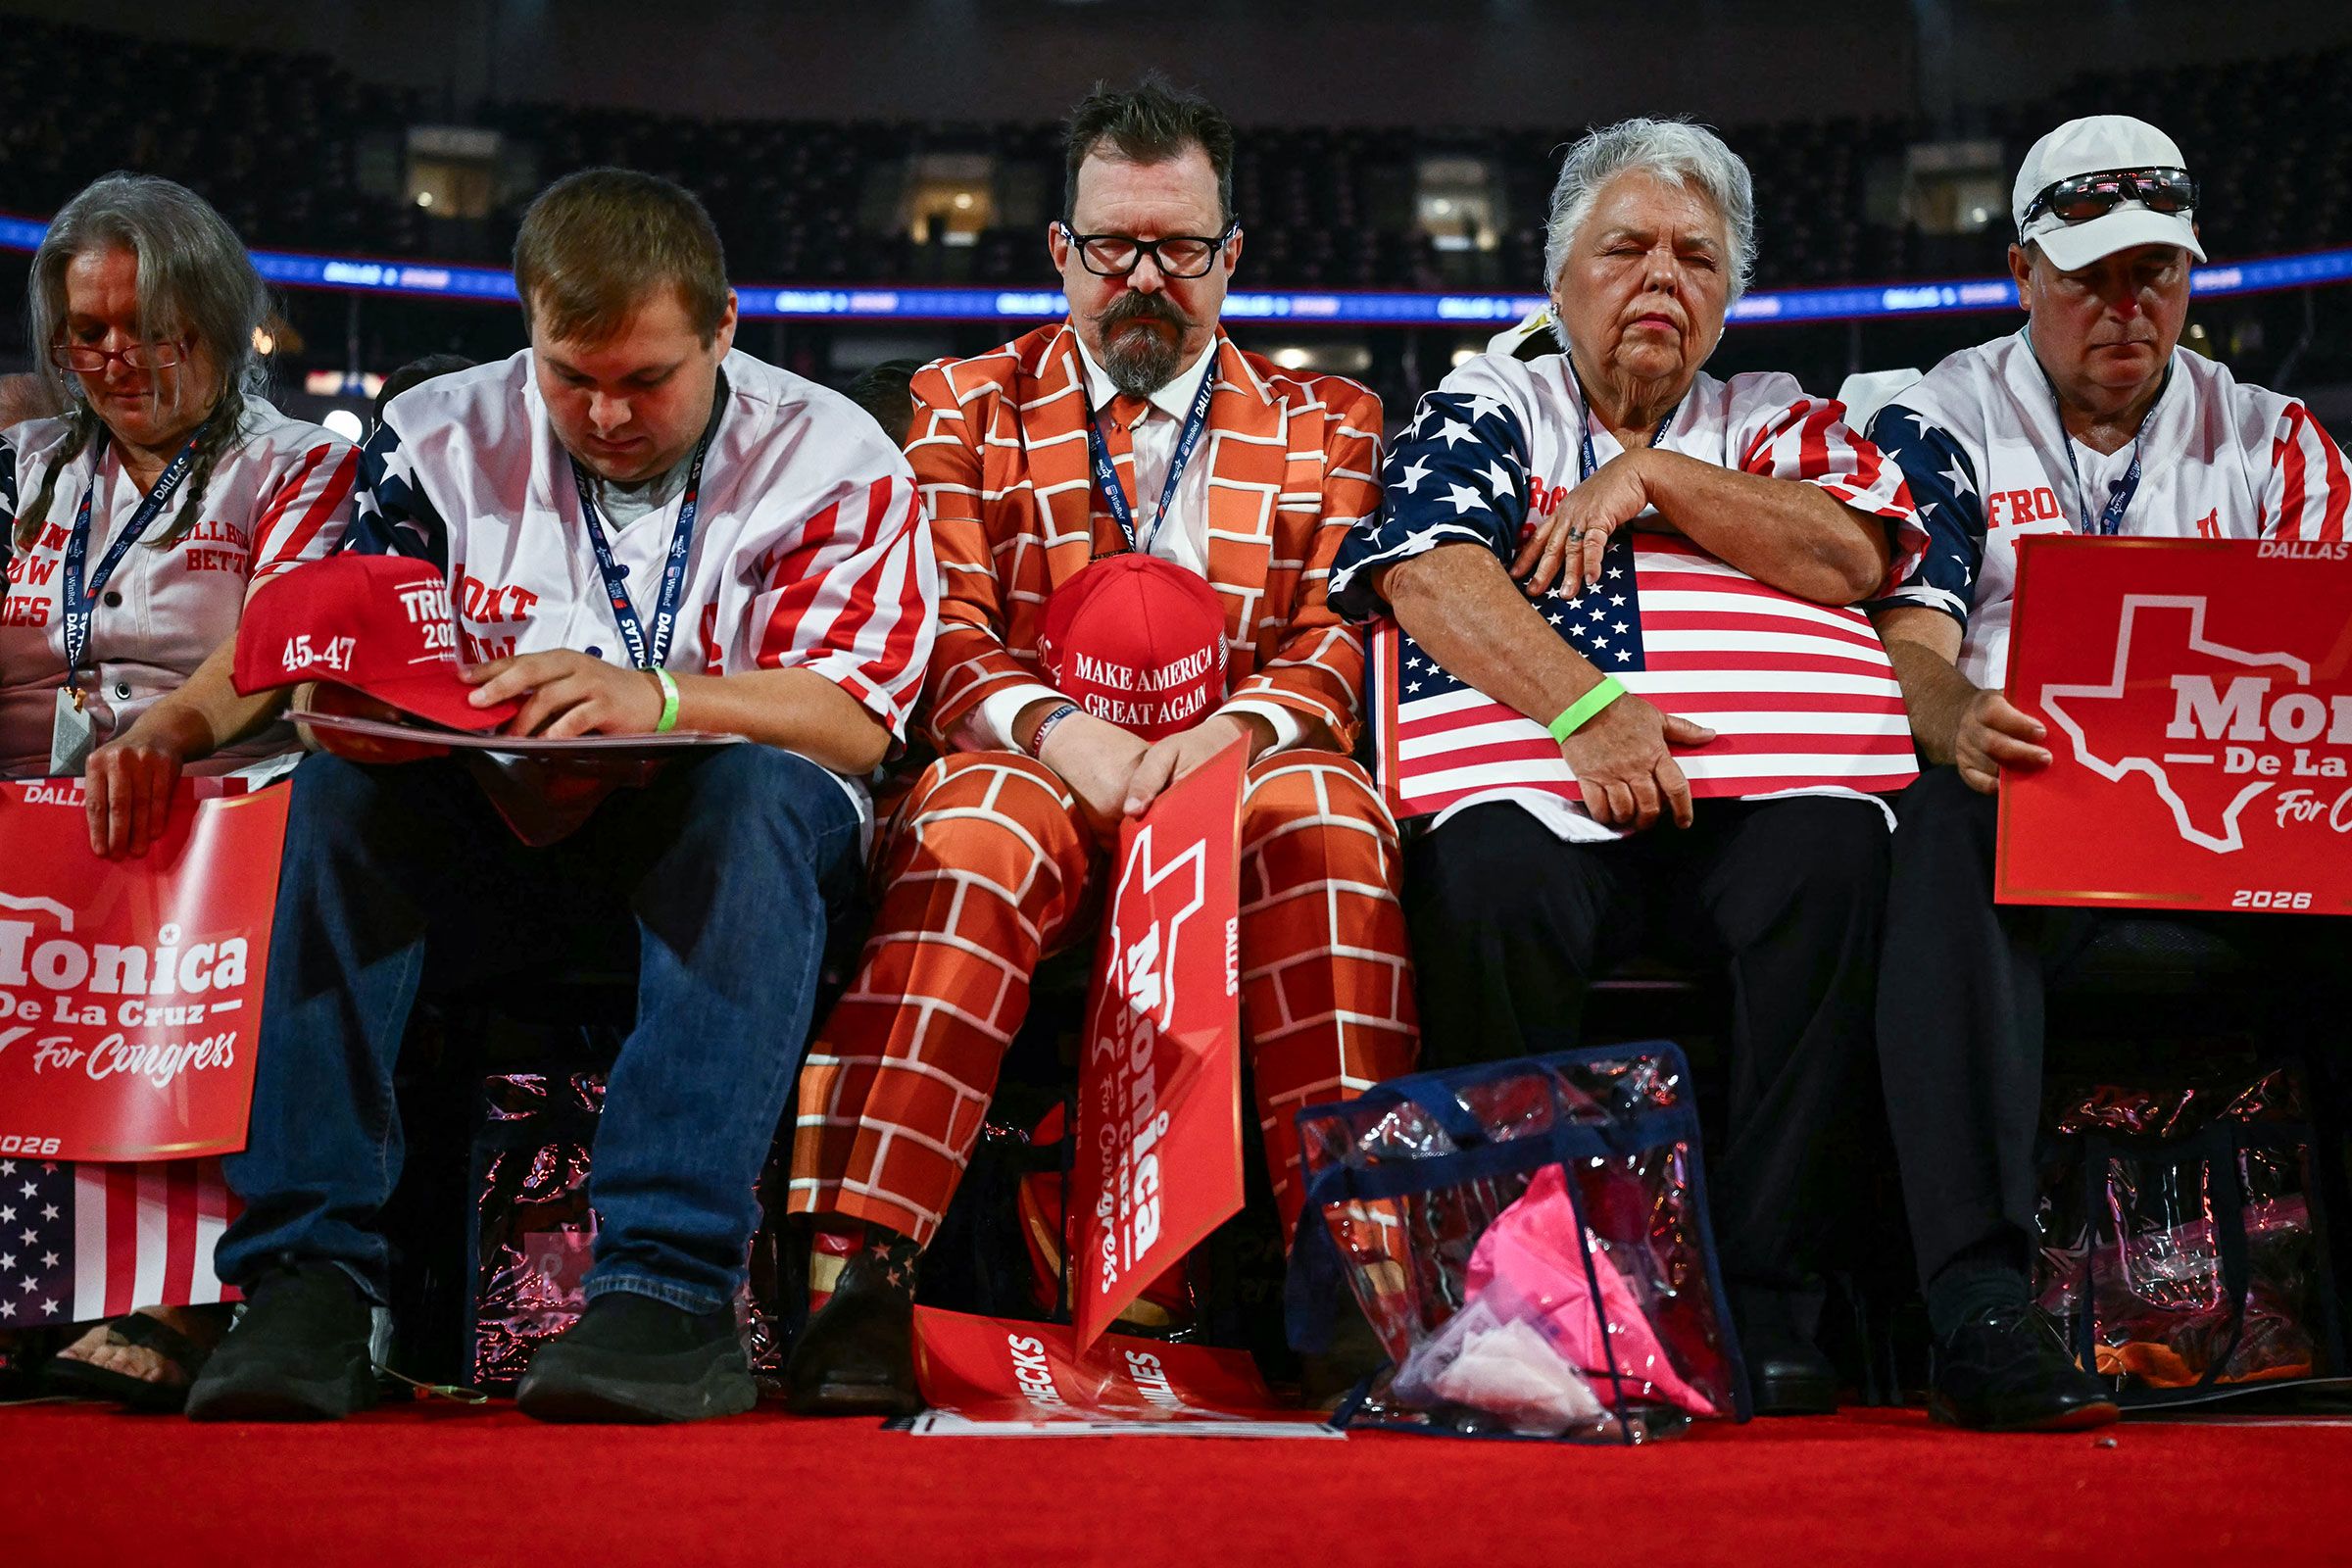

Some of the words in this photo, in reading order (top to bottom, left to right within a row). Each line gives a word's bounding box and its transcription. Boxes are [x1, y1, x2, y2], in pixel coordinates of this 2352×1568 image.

[1195, 373, 1214, 419] DALLAS
[153, 457, 189, 501] DALLAS
[1987, 487, 2066, 529] FRO
[186, 549, 248, 574] BETT
[2257, 541, 2349, 561] DALLAS
[0, 595, 52, 628] OES
[399, 589, 454, 623] TRU
[282, 634, 357, 672] 45-47
[651, 612, 671, 669] DALLAS
[1074, 652, 1133, 692] MAKE
[1136, 644, 1212, 692] AMERICA
[1084, 692, 1153, 725] GREAT
[1157, 682, 1207, 725] AGAIN
[2224, 747, 2281, 775] De
[2292, 749, 2348, 777] La
[24, 785, 88, 808] DALL
[2276, 789, 2328, 829] For
[2231, 890, 2313, 910] 2026
[1225, 917, 1240, 998] DALLAS
[53, 996, 107, 1025] La
[117, 1000, 206, 1027] Cruz
[33, 1035, 85, 1075] For
[85, 1030, 237, 1090] Congress
[1127, 919, 1170, 1262] Monica
[0, 1135, 62, 1156] 026
[1118, 1119, 1131, 1221] Cruz
